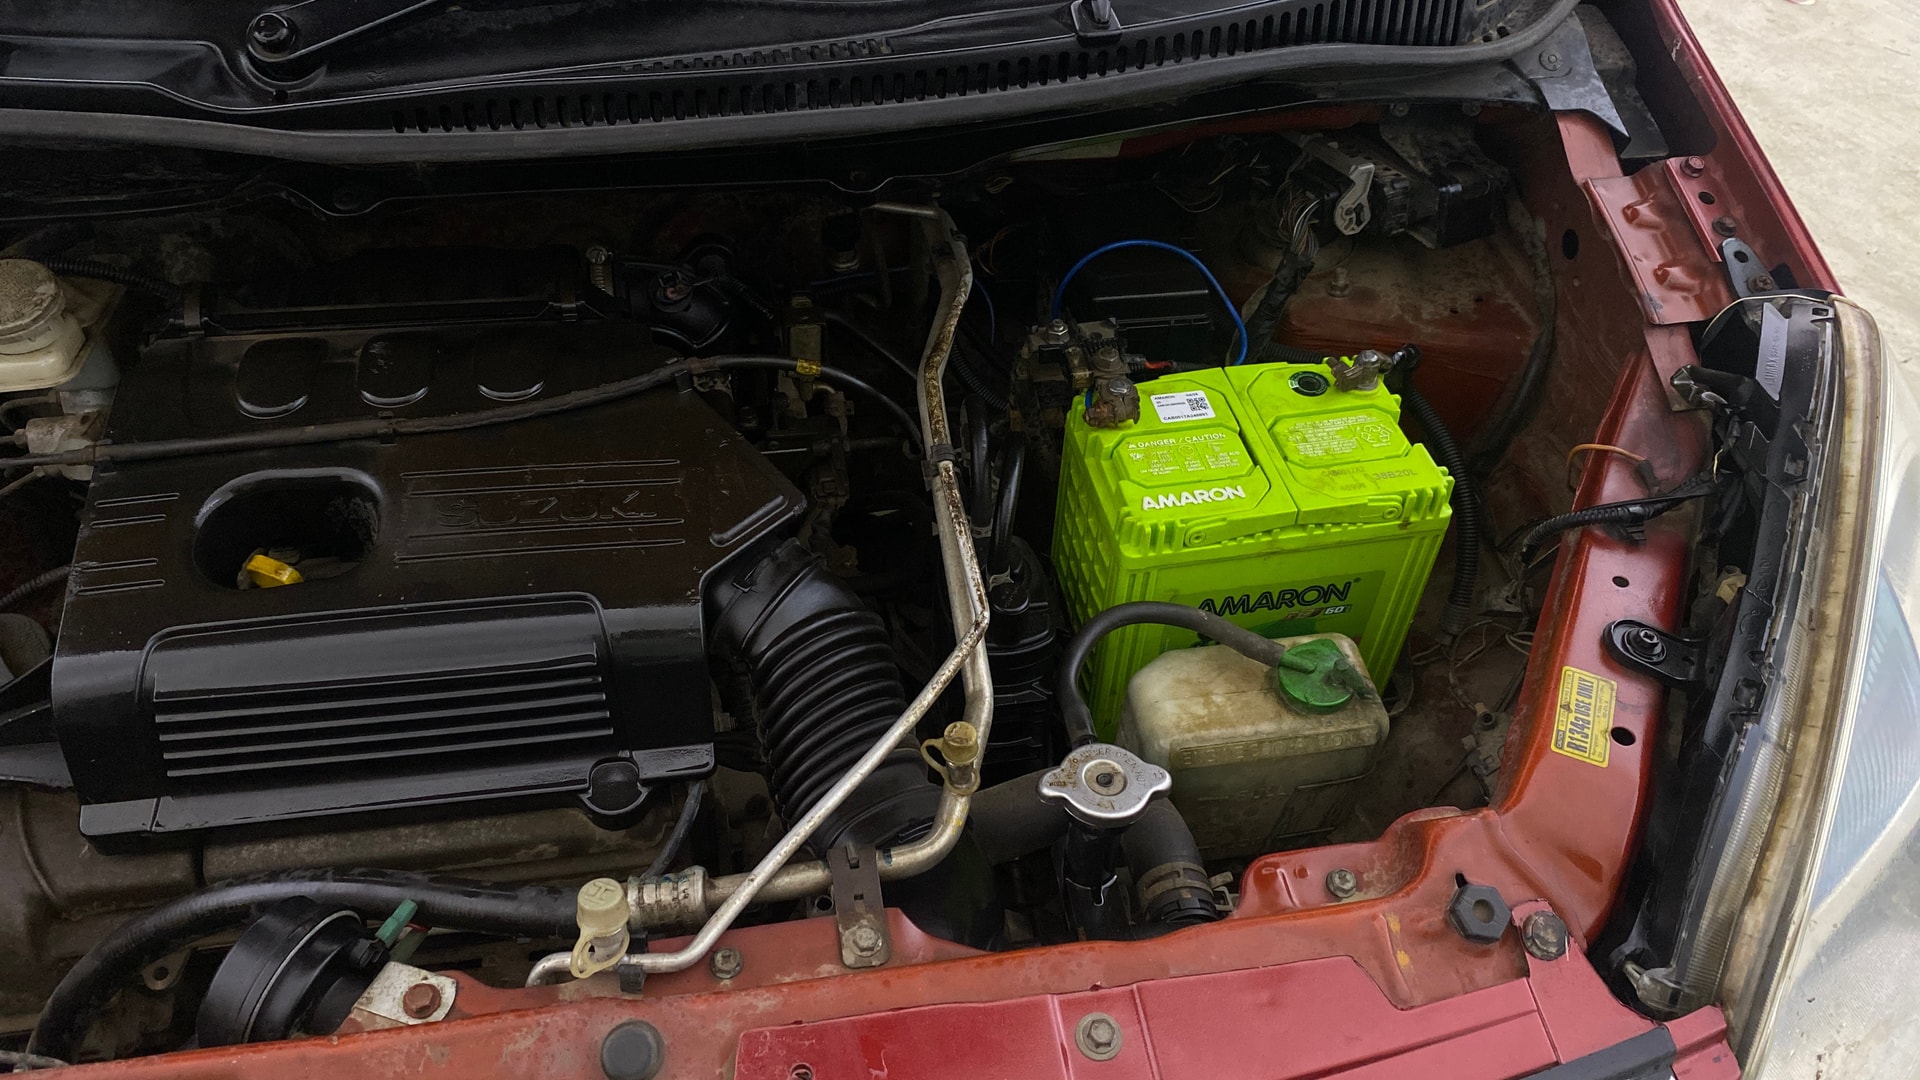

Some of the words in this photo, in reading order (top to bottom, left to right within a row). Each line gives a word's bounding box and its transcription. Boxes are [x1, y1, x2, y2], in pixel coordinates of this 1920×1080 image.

[1138, 438, 1176, 448] DANGER
[1184, 432, 1226, 443] CAUTION
[1373, 470, 1419, 481] 38B20L
[1142, 484, 1246, 511] AMARON
[1198, 581, 1352, 617] AMARON
[1576, 676, 1594, 700] ONLY
[1574, 699, 1591, 717] USE
[1566, 716, 1591, 754] R134a
